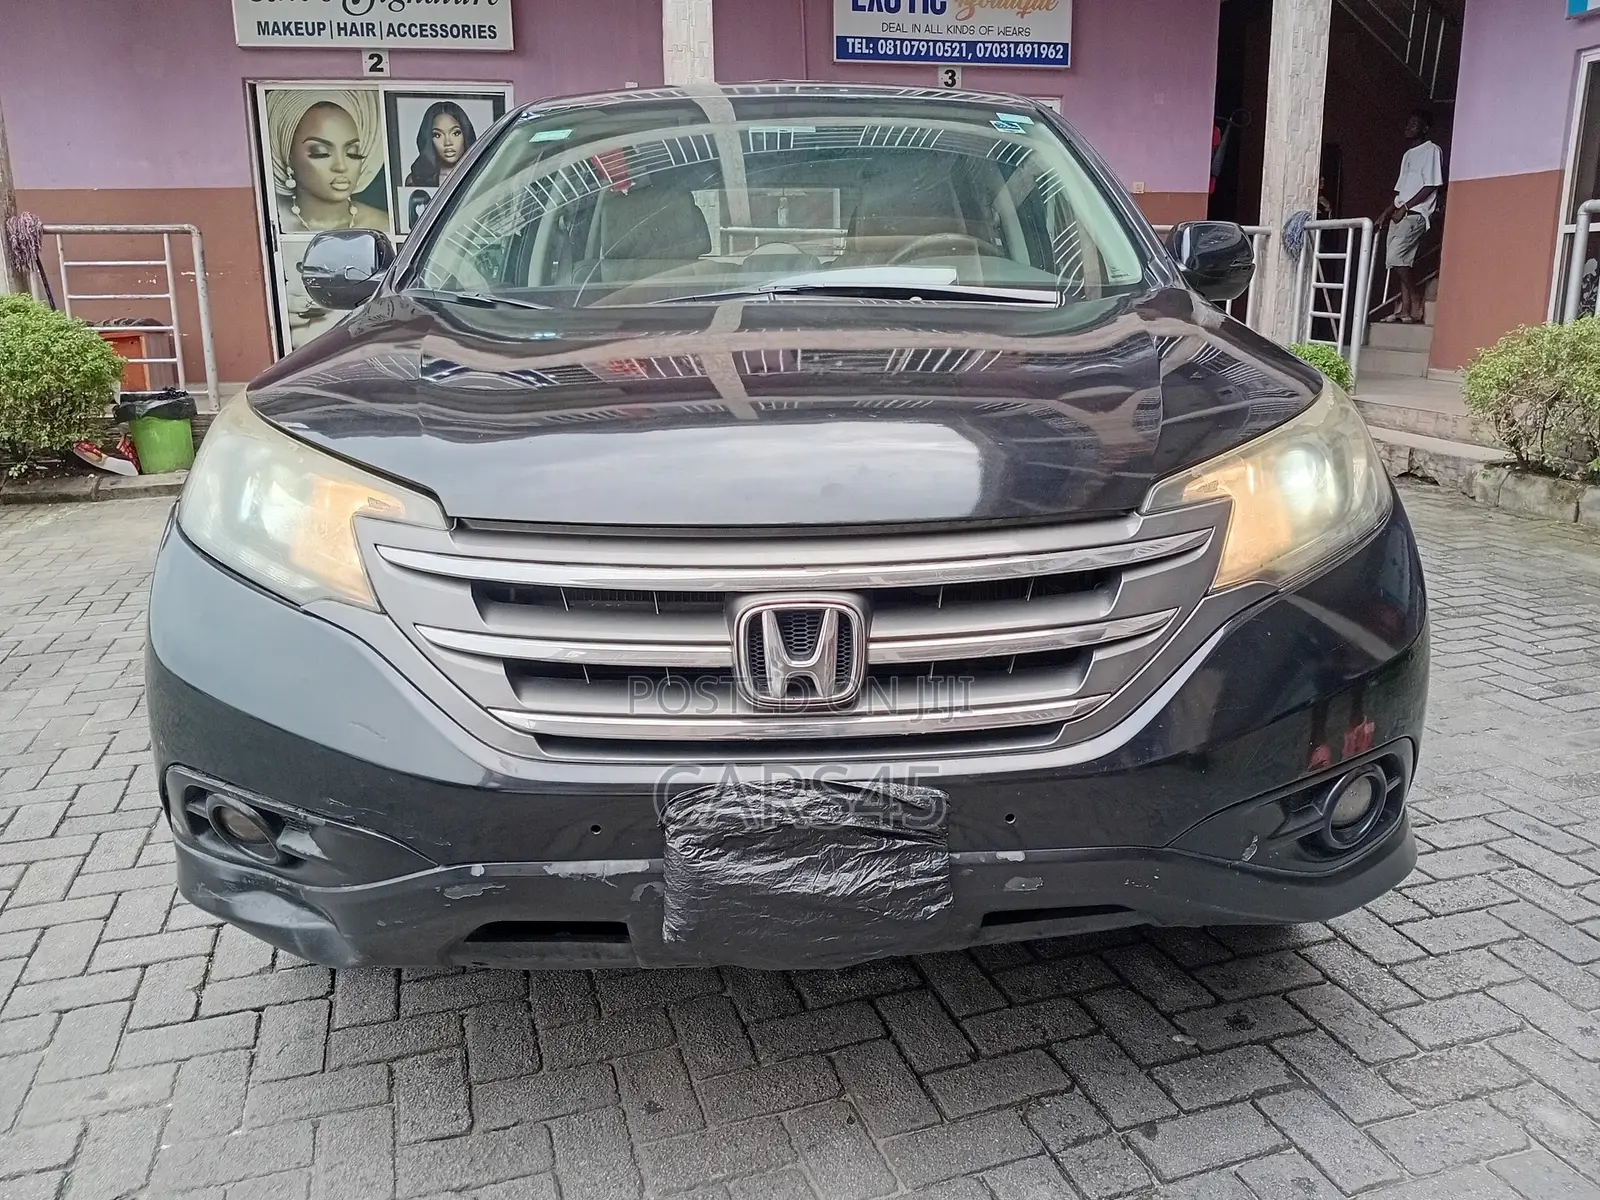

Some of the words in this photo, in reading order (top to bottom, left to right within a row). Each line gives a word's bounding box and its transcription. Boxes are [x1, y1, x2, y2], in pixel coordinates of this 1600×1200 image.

[256, 20, 327, 37] MAKEUP
[337, 22, 377, 37] HAIR
[386, 23, 498, 39] ACCESSORIES
[881, 22, 908, 33] DEAL
[911, 24, 921, 33] IN
[924, 24, 943, 34] ALL
[946, 25, 975, 35] KINDS
[978, 26, 994, 35] OF
[997, 27, 1031, 37] WEARS
[846, 38, 873, 54] TEL:
[877, 39, 972, 60] 08107910521,
[976, 43, 1064, 59] 07031491962
[368, 53, 384, 73] 2
[943, 69, 956, 88] 3
